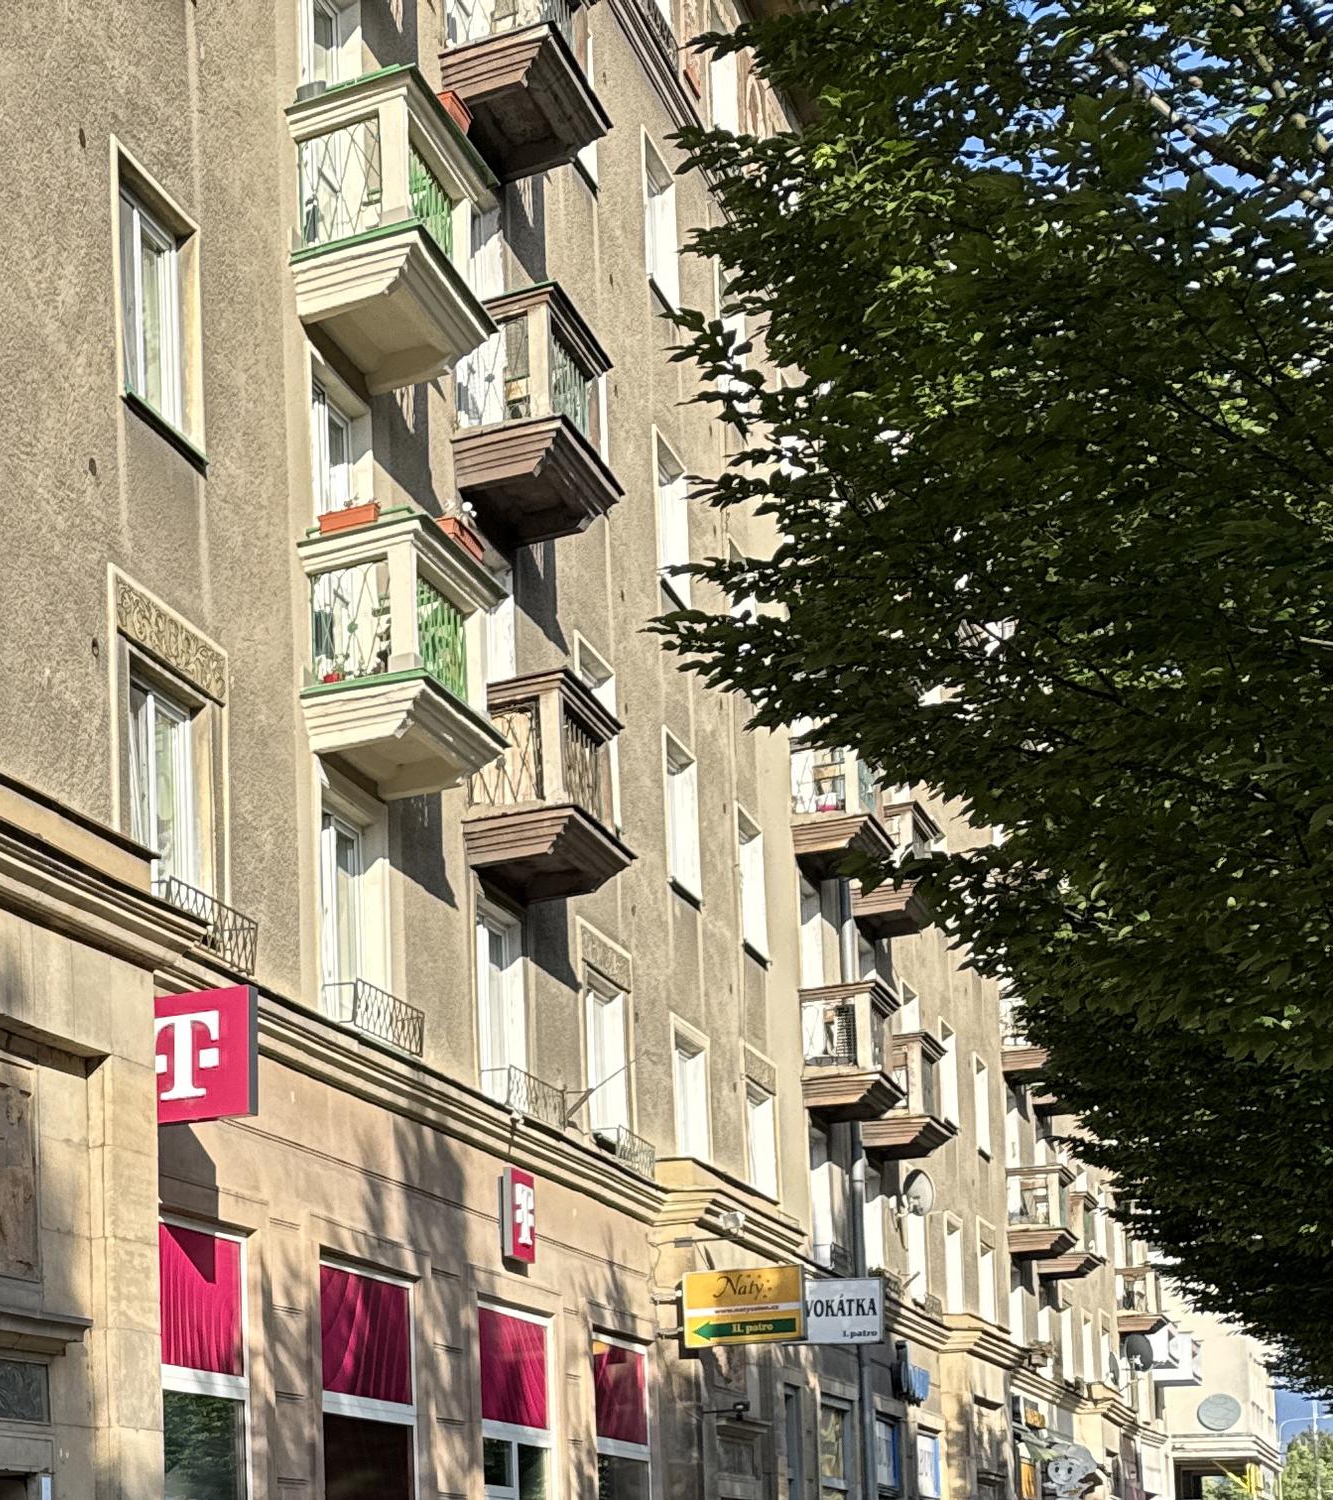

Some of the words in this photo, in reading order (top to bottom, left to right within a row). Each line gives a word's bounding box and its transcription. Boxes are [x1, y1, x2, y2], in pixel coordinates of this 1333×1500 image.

[155, 1009, 220, 1101] T
[713, 1274, 764, 1300] Naty
[746, 1322, 773, 1334] patro
[849, 1330, 878, 1339] patro
